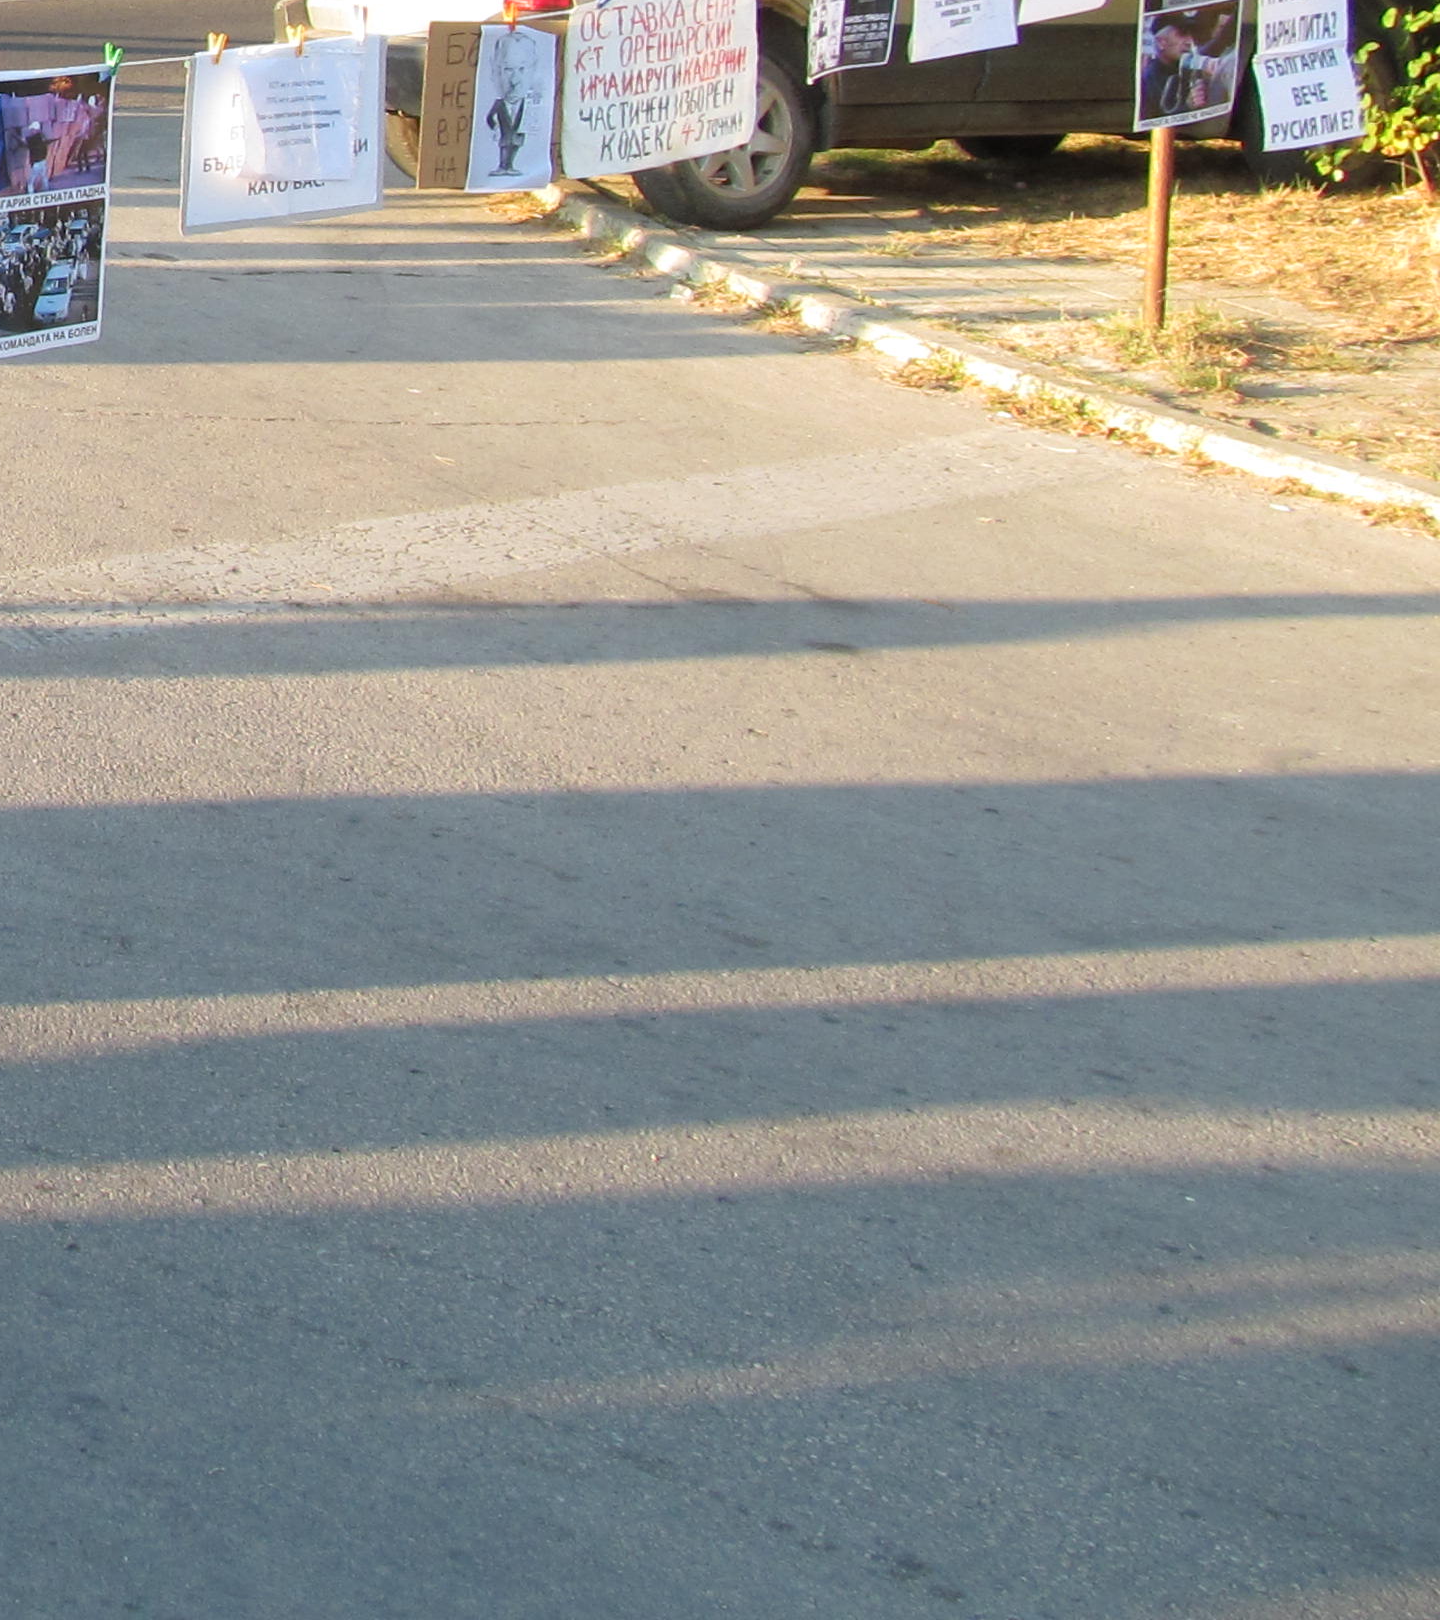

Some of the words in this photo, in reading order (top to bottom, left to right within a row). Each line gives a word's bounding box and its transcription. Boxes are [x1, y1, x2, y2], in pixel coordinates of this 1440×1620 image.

[1299, 11, 1337, 42] ПИТА?
[619, 20, 732, 68] ОРЕШАРСКИ!
[1264, 48, 1339, 79] БЪЛГАРИЯ
[579, 95, 669, 131] ЧАСТИЧЕН
[674, 78, 734, 118] ИЗБОРЕН
[1291, 82, 1328, 107] ВЕЧЕ
[600, 121, 677, 162] КОДЕКС
[1271, 117, 1318, 144] РУСИЯ
[1320, 111, 1339, 135] ЛИ
[1340, 110, 1355, 131] Е?
[33, 191, 74, 206] СТЕНАТА
[75, 185, 106, 199] ПАДНА
[53, 330, 65, 340] НА
